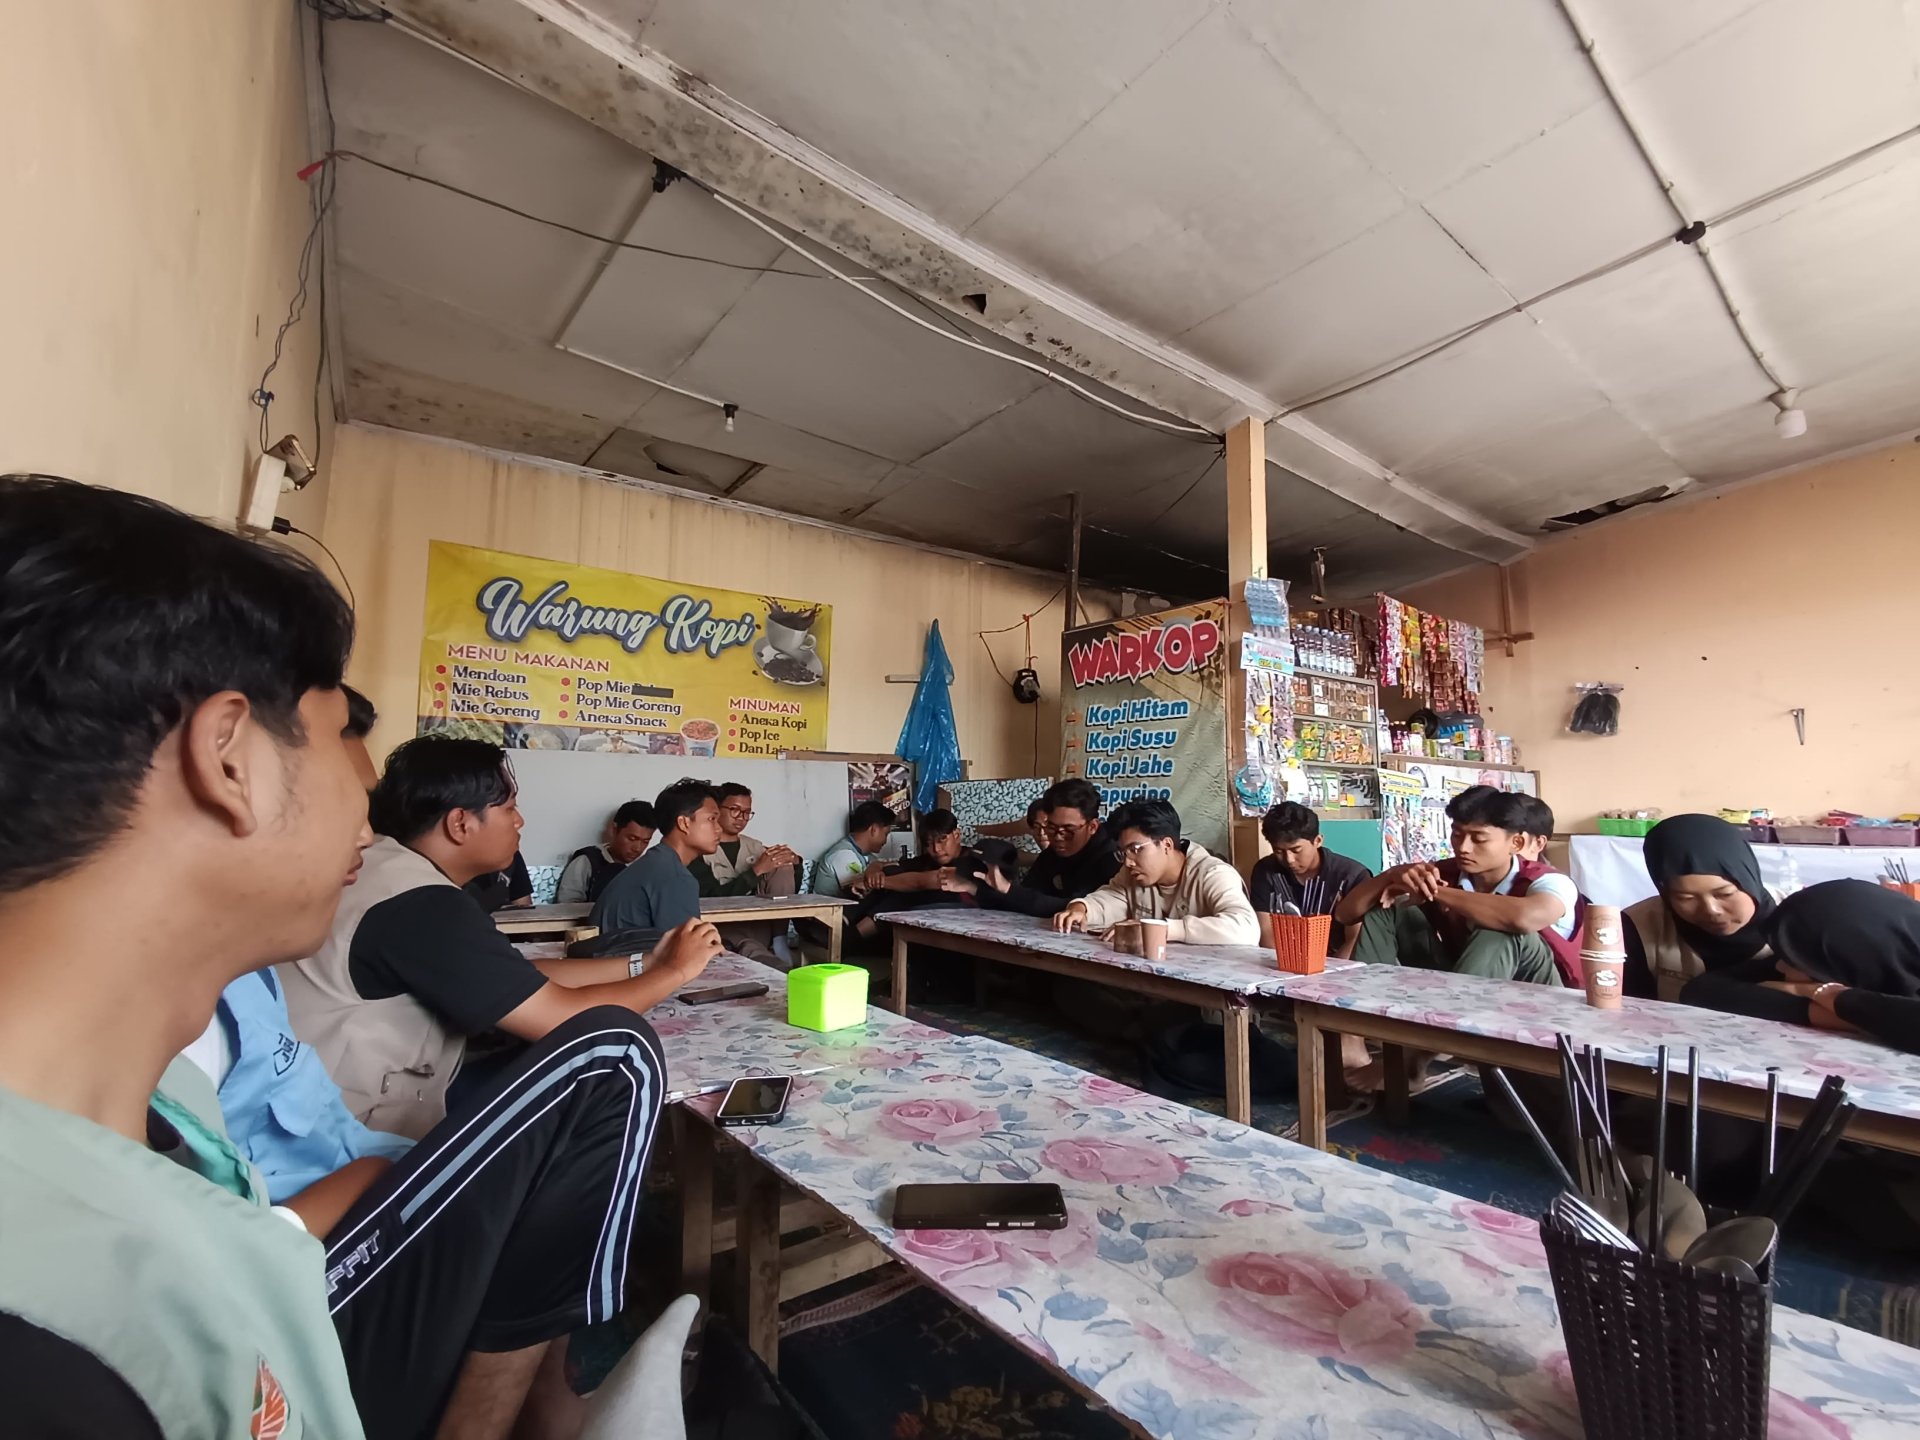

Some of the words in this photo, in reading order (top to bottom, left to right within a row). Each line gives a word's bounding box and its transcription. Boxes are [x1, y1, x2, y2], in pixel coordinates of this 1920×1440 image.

[477, 578, 660, 651] Warung
[662, 596, 755, 657] Kopi
[447, 644, 508, 662] MENU
[514, 651, 609, 673] MAKANAN
[1068, 620, 1219, 688] WARKOP
[452, 664, 527, 684] Mendoan
[577, 677, 603, 694] Pop
[605, 680, 631, 694] Mie
[451, 681, 481, 697] Mie
[484, 684, 530, 701] Rebus
[450, 698, 480, 714] Mie
[482, 701, 541, 721] Goreng
[576, 693, 602, 710] Pop
[604, 695, 630, 709] Mie
[632, 698, 681, 716] Goreng
[729, 698, 801, 714] MINUMAN
[1087, 702, 1128, 727] Kopi
[1129, 698, 1189, 720] Hitam
[575, 709, 622, 725] Aneka
[624, 713, 668, 728] Snack
[740, 713, 779, 727] Aneka
[781, 716, 807, 732] Kopi
[740, 727, 762, 743] Pop
[763, 729, 780, 741] Ice
[1087, 729, 1128, 753] Kopi
[1130, 728, 1178, 747] Susu
[739, 742, 764, 755] Dan
[1087, 755, 1128, 780] Kopi
[1129, 754, 1174, 775] Jahe
[325, 1229, 380, 1295] FFIT
